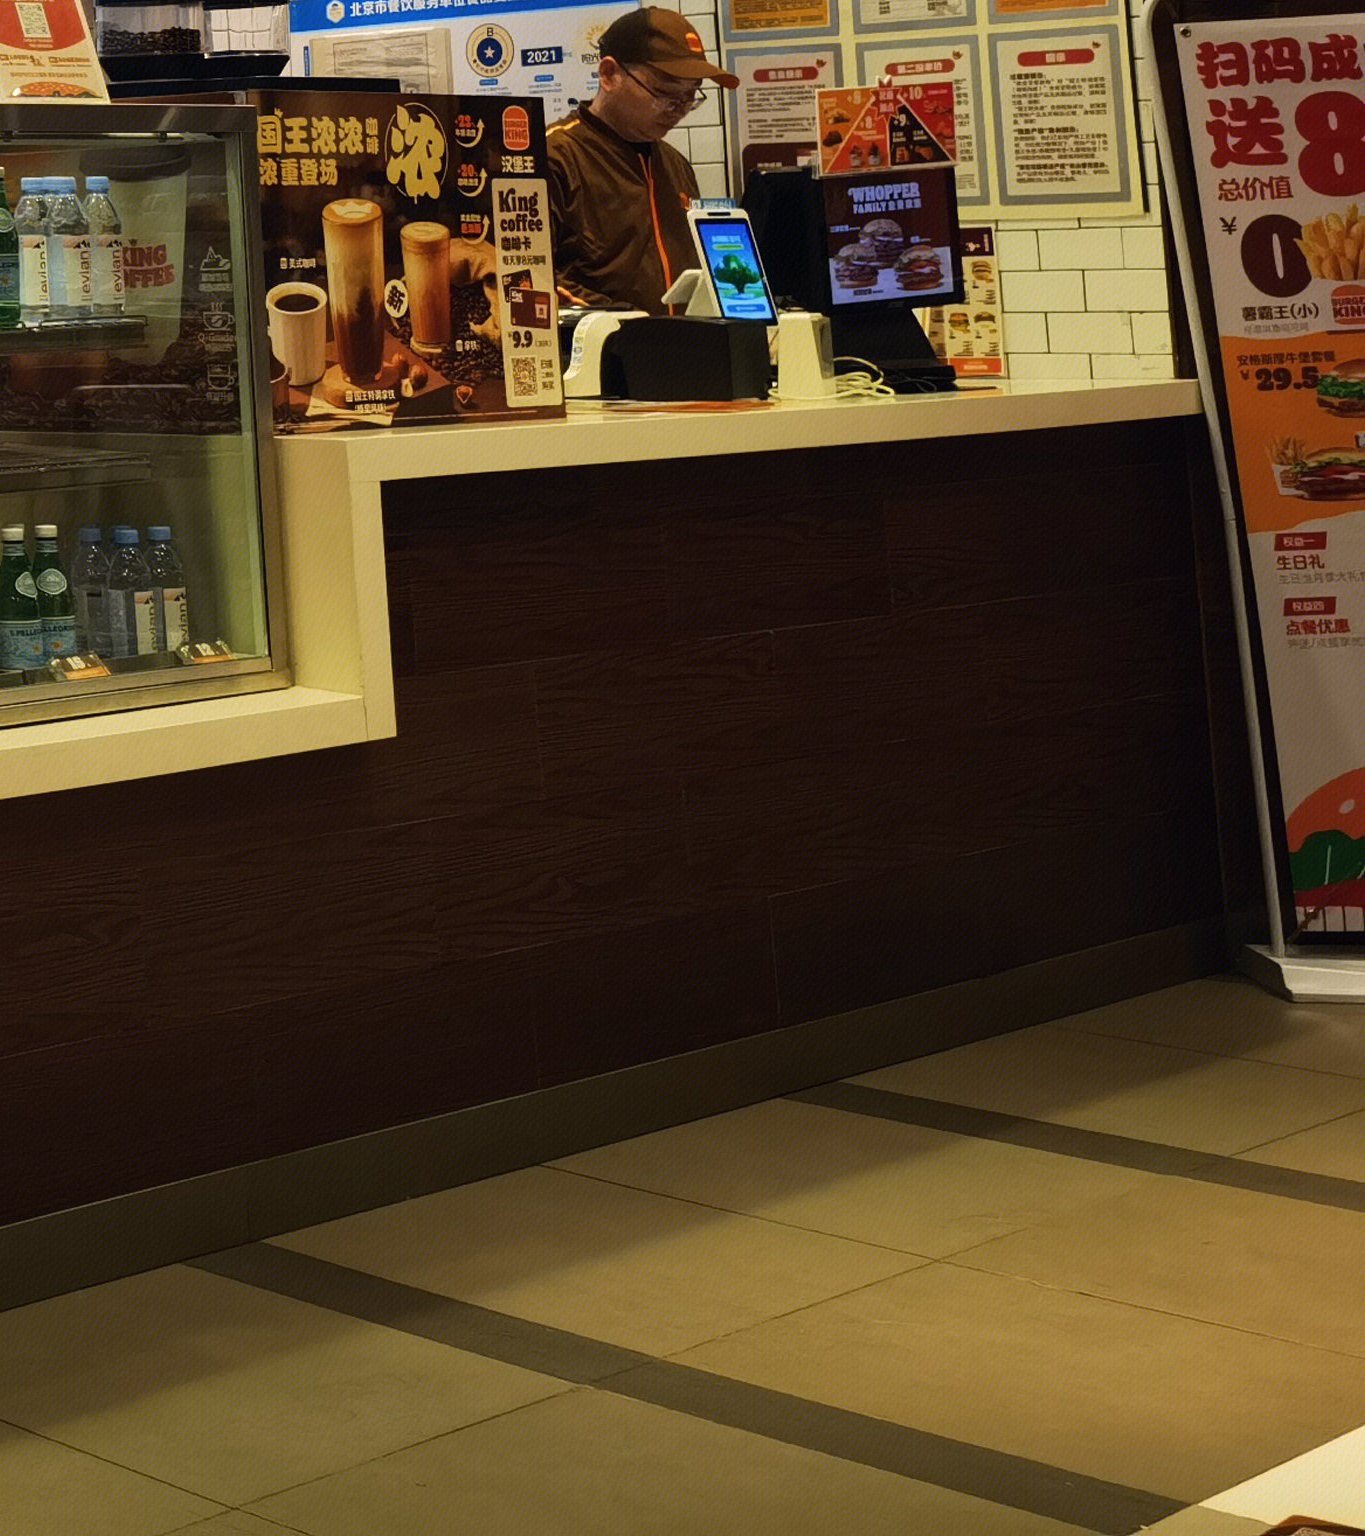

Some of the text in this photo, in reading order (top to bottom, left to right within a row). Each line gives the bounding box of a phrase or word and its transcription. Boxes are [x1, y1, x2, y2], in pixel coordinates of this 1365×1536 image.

[526, 49, 558, 64] 2021
[1195, 33, 1364, 90] 扫码成
[256, 111, 364, 156] 国王浓浓
[504, 128, 529, 142] KING
[385, 104, 446, 205] 浓
[500, 155, 536, 175] 汉堡王
[258, 158, 339, 187] 浓重登场
[847, 181, 921, 204] WHOPPER
[1218, 175, 1294, 203] 总价值
[498, 187, 539, 215] King
[852, 203, 888, 215] FAMILY
[500, 211, 544, 233] coffee
[123, 244, 168, 267] KING
[500, 236, 532, 252] 咖啡卡
[80, 249, 91, 297] evian
[386, 285, 406, 314] 新
[1241, 303, 1321, 323] 薯霸王(小)
[1275, 553, 1326, 571] 生日礼
[1286, 618, 1351, 637] 点餐优惠
